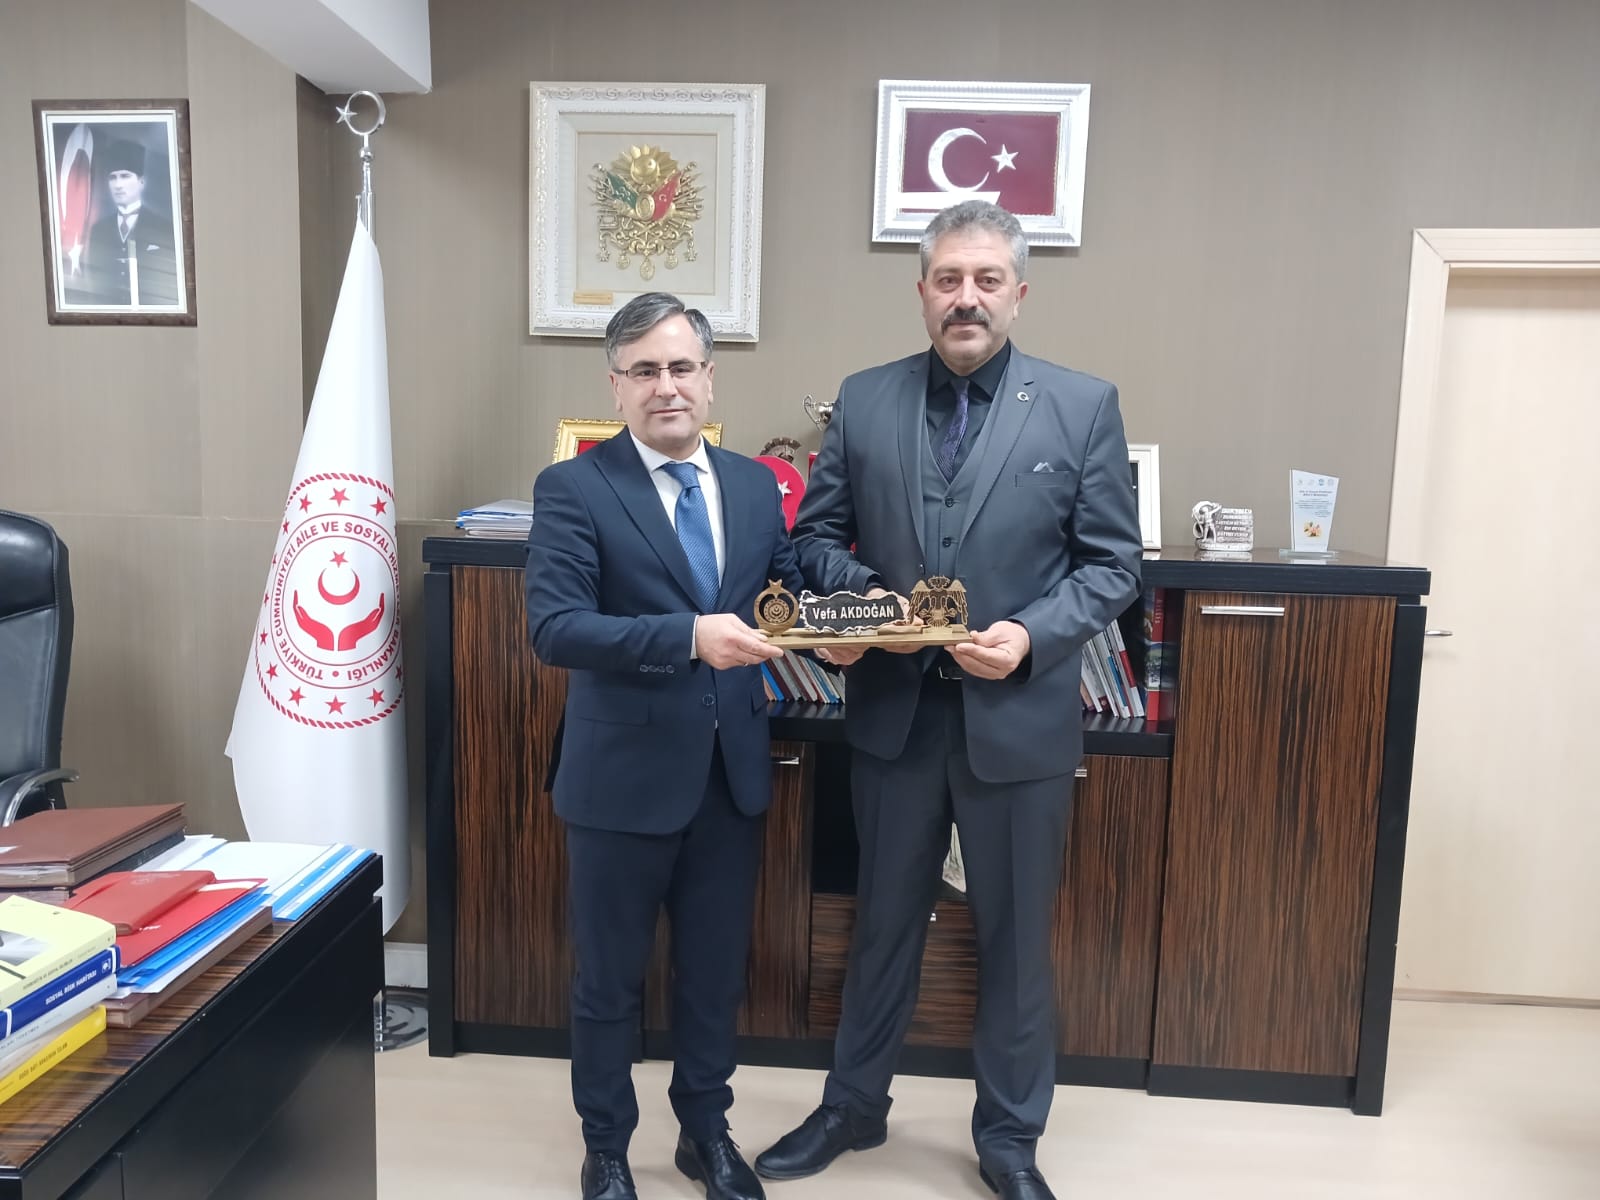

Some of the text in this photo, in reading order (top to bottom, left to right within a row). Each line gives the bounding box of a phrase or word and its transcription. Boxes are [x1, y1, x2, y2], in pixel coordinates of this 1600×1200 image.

[296, 525, 318, 547] AİLE
[321, 521, 339, 532] VE
[344, 521, 389, 553] SOSYAL
[274, 543, 296, 637] CUMHURİYETİ
[813, 603, 894, 620] Vefa AKDOĞAN
[279, 638, 323, 680] TÜRKİYE
[347, 629, 399, 681] BAKANLIĞI
